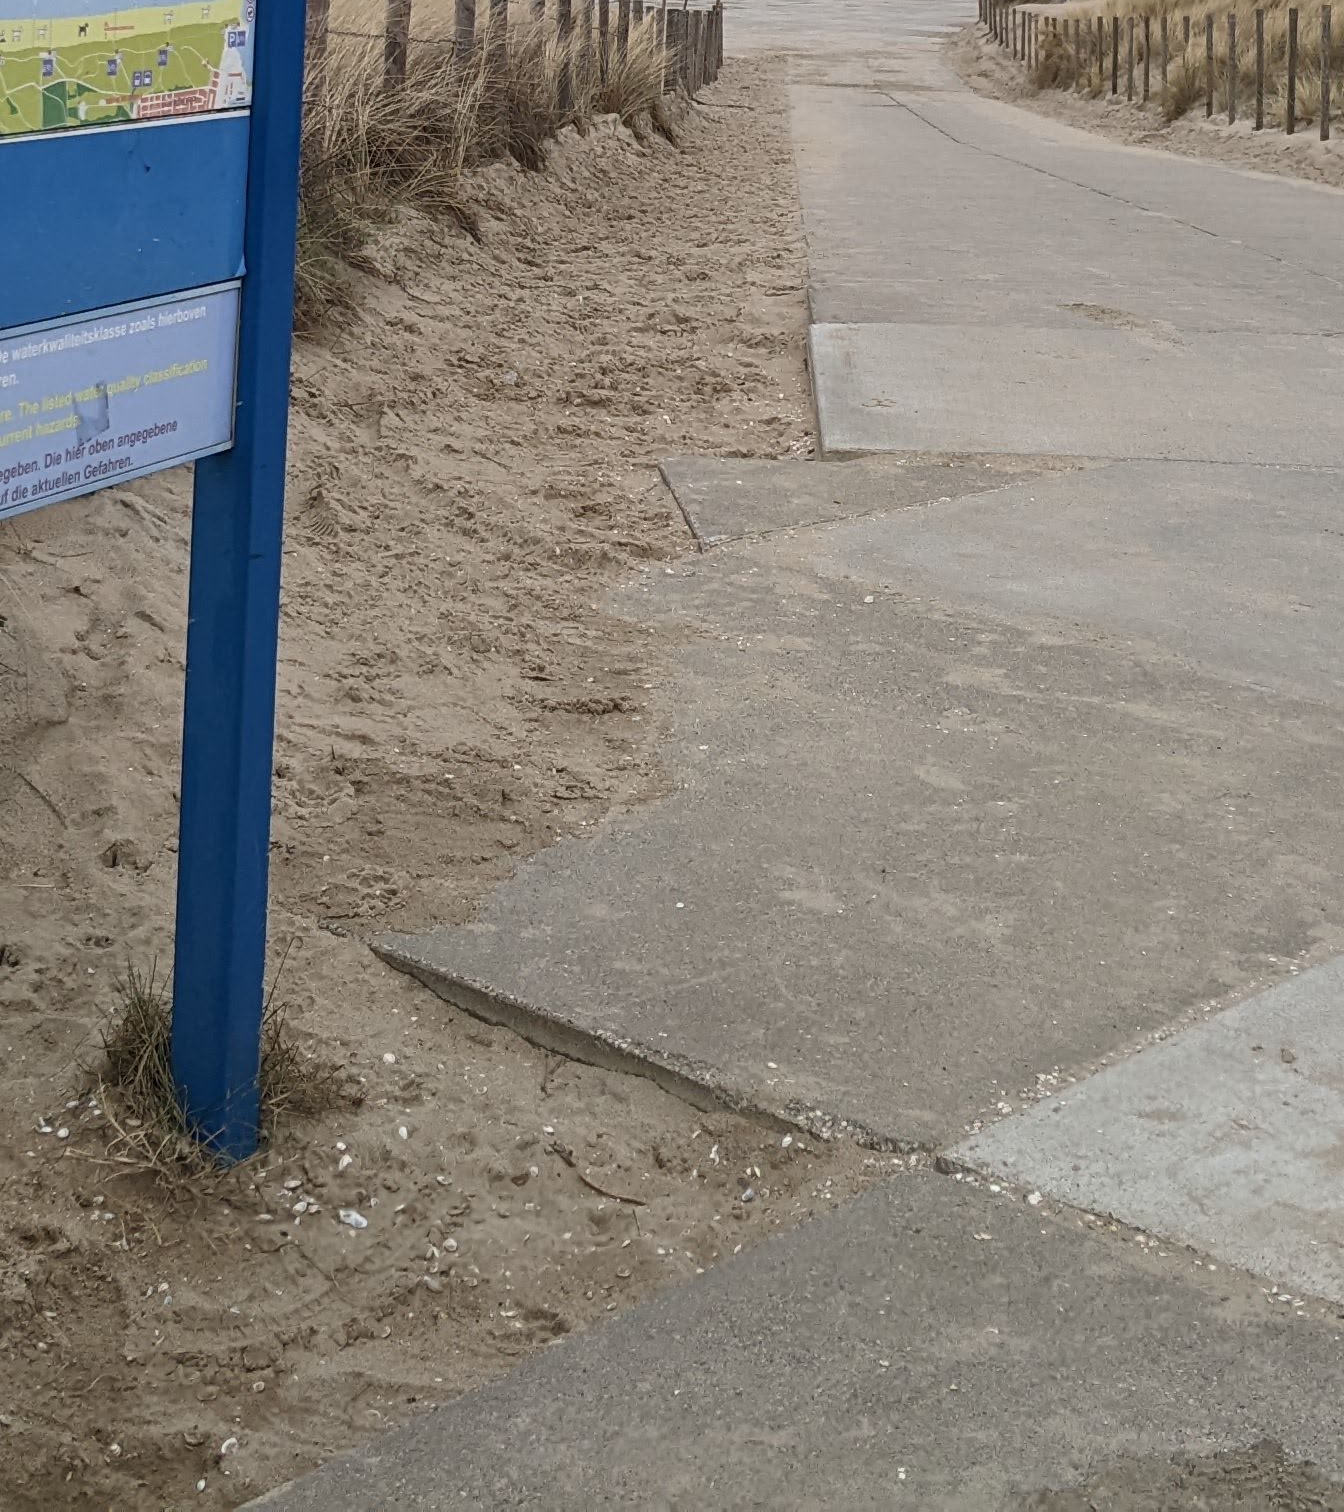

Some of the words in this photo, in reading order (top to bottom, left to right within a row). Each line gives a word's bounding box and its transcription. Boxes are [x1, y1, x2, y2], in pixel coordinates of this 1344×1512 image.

[12, 324, 126, 361] waterkwaliteitsklasse
[129, 315, 156, 334] zoals
[158, 305, 207, 327] hierboven
[19, 400, 39, 418] The
[42, 392, 73, 412] listed
[106, 374, 141, 397] quality
[143, 358, 208, 386] classification
[44, 452, 62, 470] Die
[65, 444, 86, 462] hier
[88, 438, 115, 457] oben
[117, 418, 178, 448] angegebene
[11, 482, 29, 502] die
[31, 469, 80, 496] aktuellen
[83, 454, 134, 480] Gefahren.
